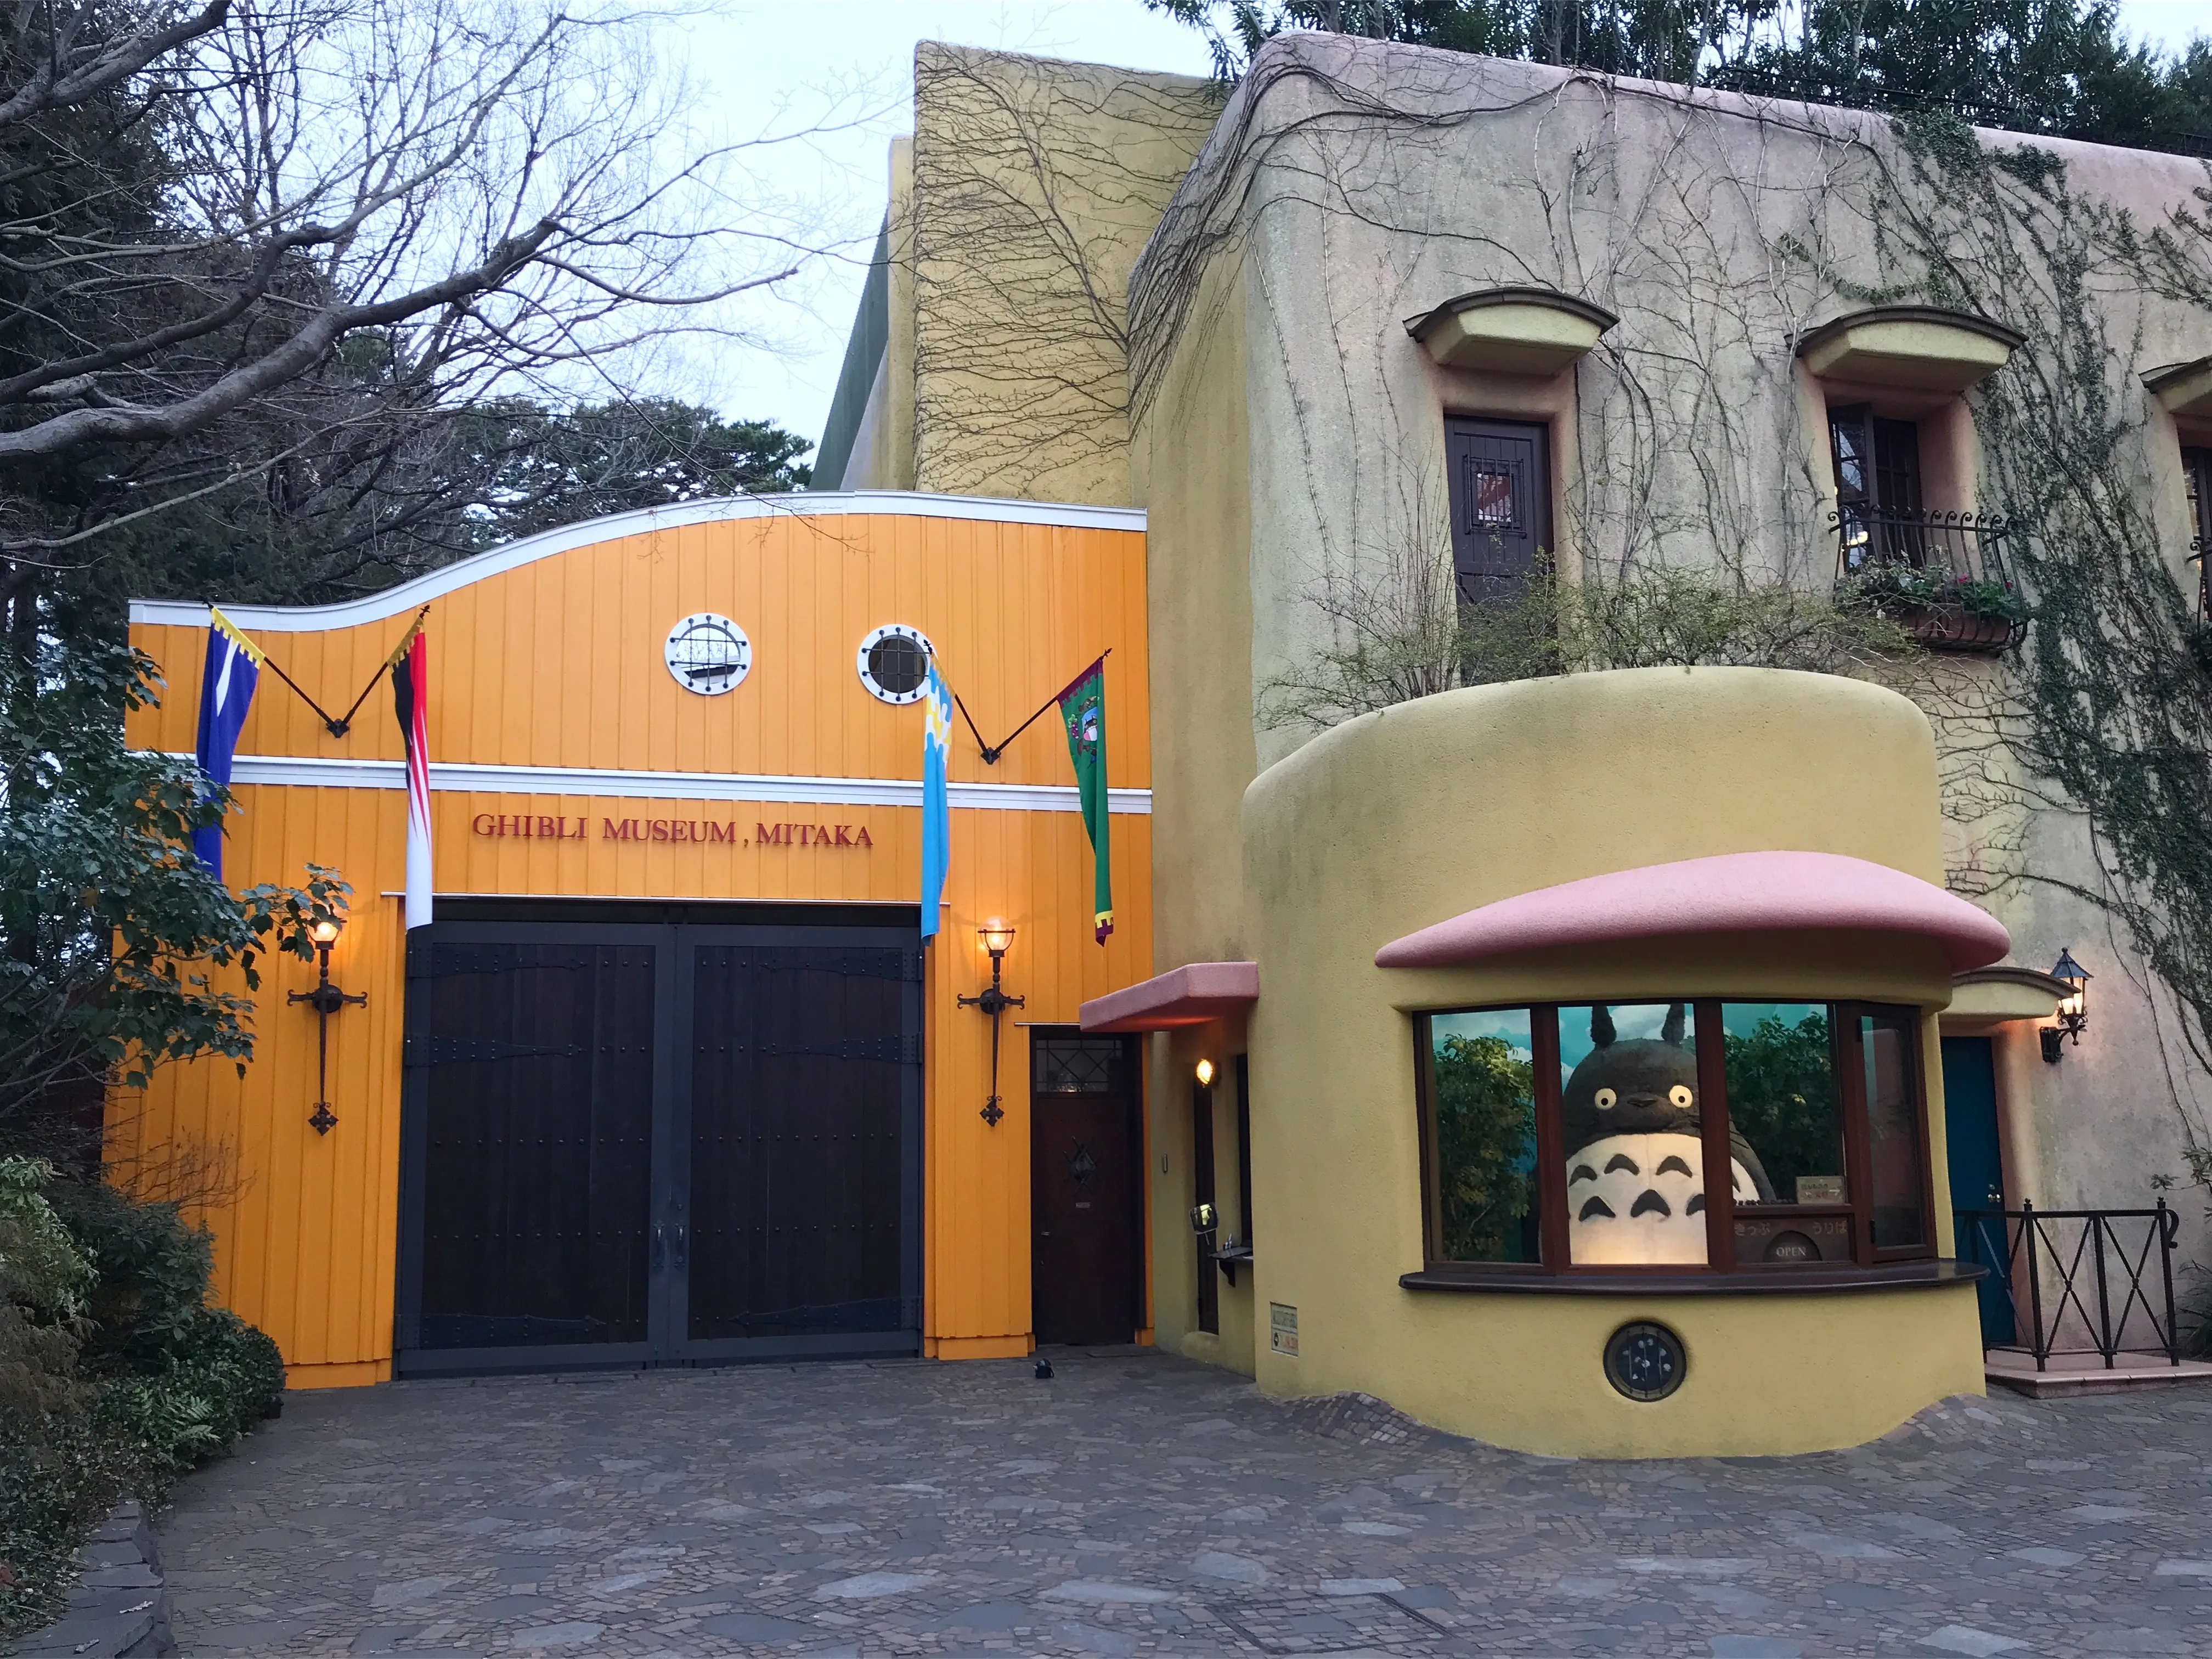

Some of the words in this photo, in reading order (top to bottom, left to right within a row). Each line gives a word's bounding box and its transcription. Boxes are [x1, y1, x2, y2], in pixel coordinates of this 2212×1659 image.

[473, 814, 588, 839] GHIBLI
[755, 823, 873, 846] MITAKA
[1776, 1247, 1806, 1257] OPEN
